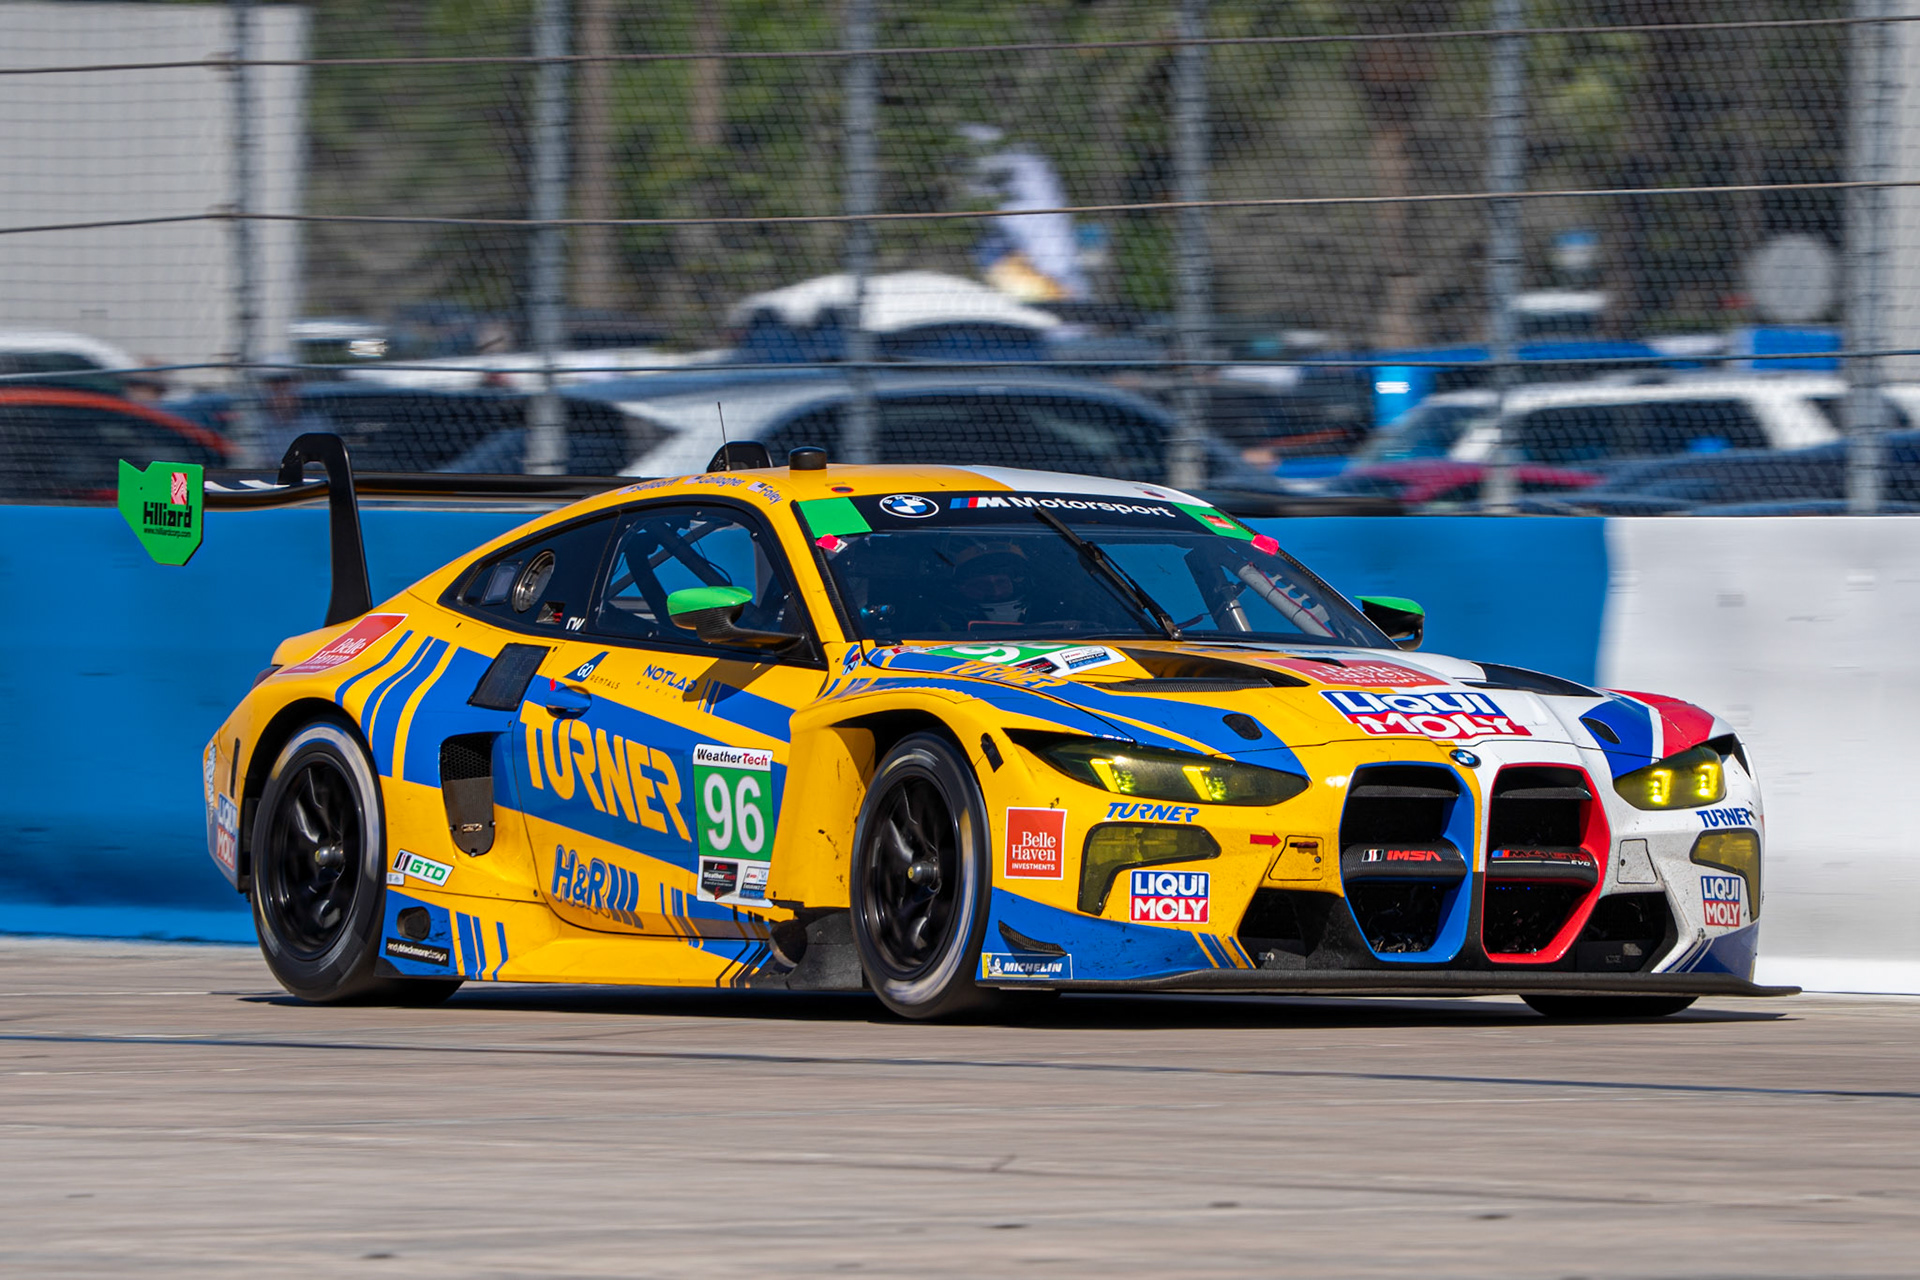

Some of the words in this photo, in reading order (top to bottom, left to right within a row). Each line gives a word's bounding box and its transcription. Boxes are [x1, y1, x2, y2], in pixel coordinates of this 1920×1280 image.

[758, 485, 783, 506] Foley
[1007, 496, 1176, 518] Motorsport
[577, 663, 594, 678] GO
[1331, 692, 1497, 715] LIQUI
[1356, 711, 1516, 738] MOLY
[697, 748, 769, 767] WeatherTech
[519, 700, 693, 843] TURNER
[703, 772, 766, 854] 96
[1106, 802, 1200, 823] TURNER
[1695, 807, 1753, 828] TURNER
[1021, 831, 1057, 848] Belle
[1011, 844, 1057, 862] Haven
[1386, 850, 1443, 862] IMSA
[1570, 859, 1591, 867] EVO
[409, 858, 446, 881] GTD
[1011, 862, 1056, 871] INVESTMENTS
[1134, 873, 1206, 897] LIQUI
[1702, 878, 1740, 901] LIQUI
[1133, 898, 1208, 921] MOLY
[1704, 902, 1740, 925] MOLY
[1003, 962, 1063, 974] MICHELIN
